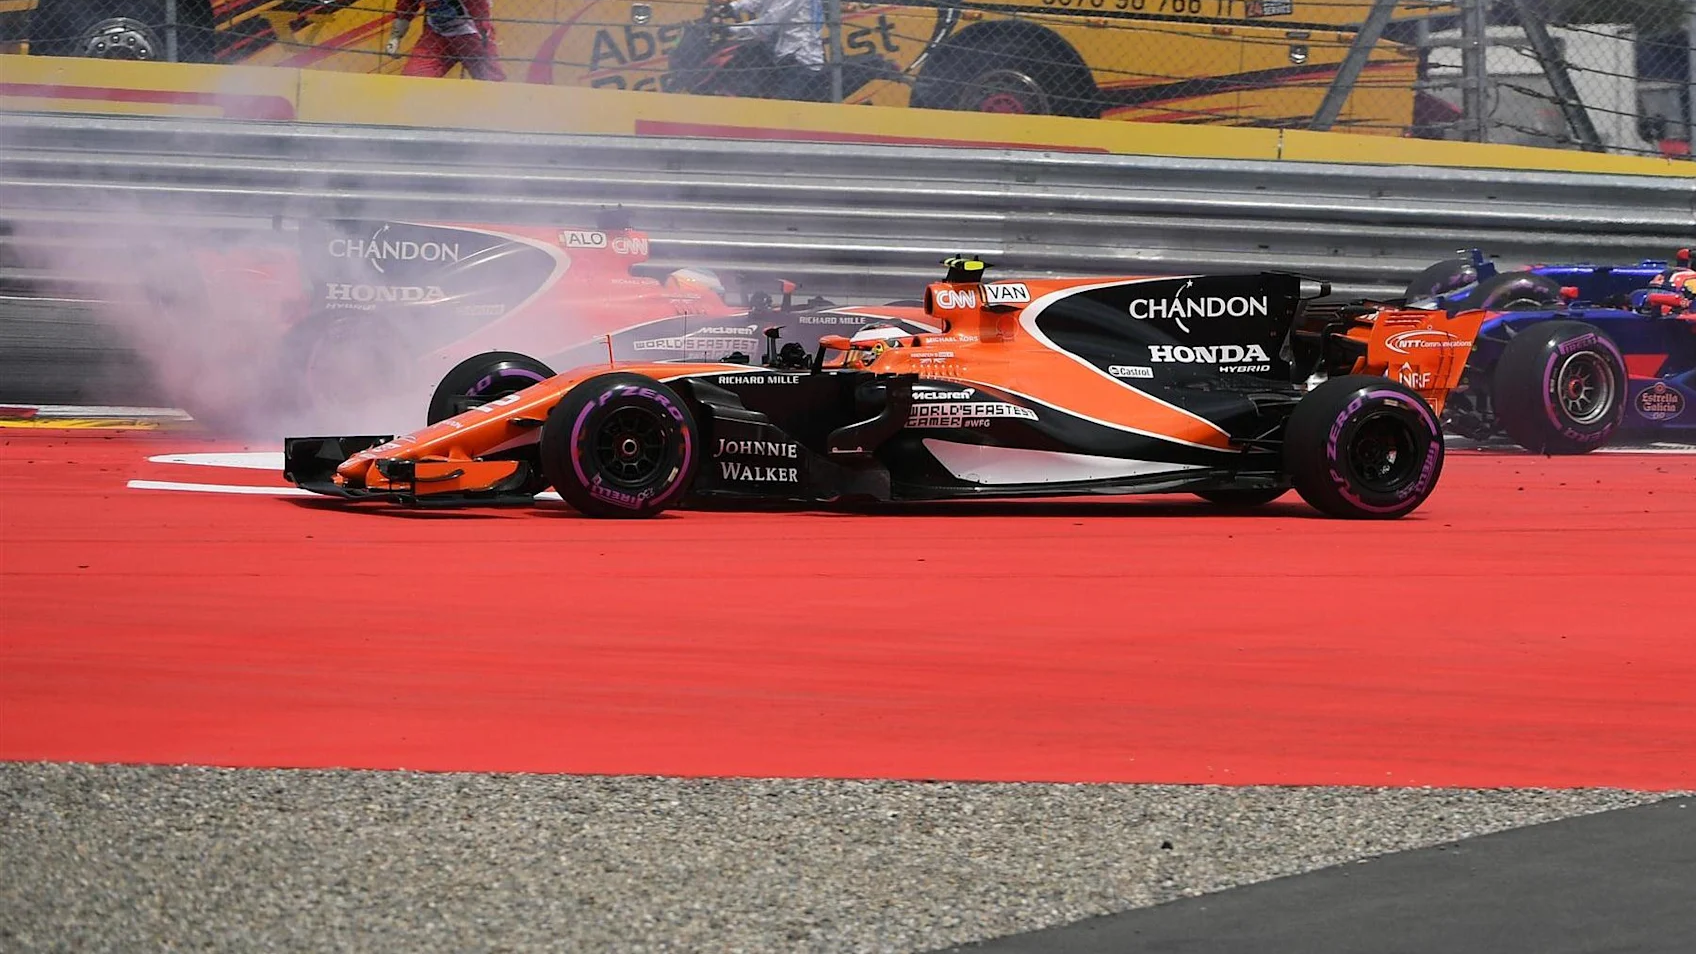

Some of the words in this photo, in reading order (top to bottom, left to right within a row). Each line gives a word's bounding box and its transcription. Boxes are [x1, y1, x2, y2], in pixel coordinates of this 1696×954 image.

[567, 231, 605, 246] ALO
[611, 236, 649, 255] CNN
[328, 238, 460, 263] CHANDON
[325, 282, 447, 302] HONDA
[935, 289, 976, 309] CNN
[987, 285, 1027, 300] VAN
[1129, 295, 1268, 320] CHANDON
[799, 316, 838, 325] RICHARD
[838, 316, 866, 325] MILLE
[700, 326, 752, 335] McLaren
[1148, 344, 1271, 364] HONDA
[1119, 366, 1152, 378] Castrol
[1219, 364, 1271, 373] HYBRID
[718, 375, 765, 385] RICHARD
[766, 375, 800, 385] MILLE
[911, 390, 971, 400] McLaren
[1641, 392, 1679, 403] Estrella
[620, 385, 684, 422] ZERO
[1642, 402, 1677, 413] Galicia
[911, 404, 973, 416] WORLD'S
[975, 404, 1036, 419] FASTEST
[905, 417, 962, 427] GAMER
[964, 418, 991, 428] #WFG
[719, 461, 799, 483] WALKER
